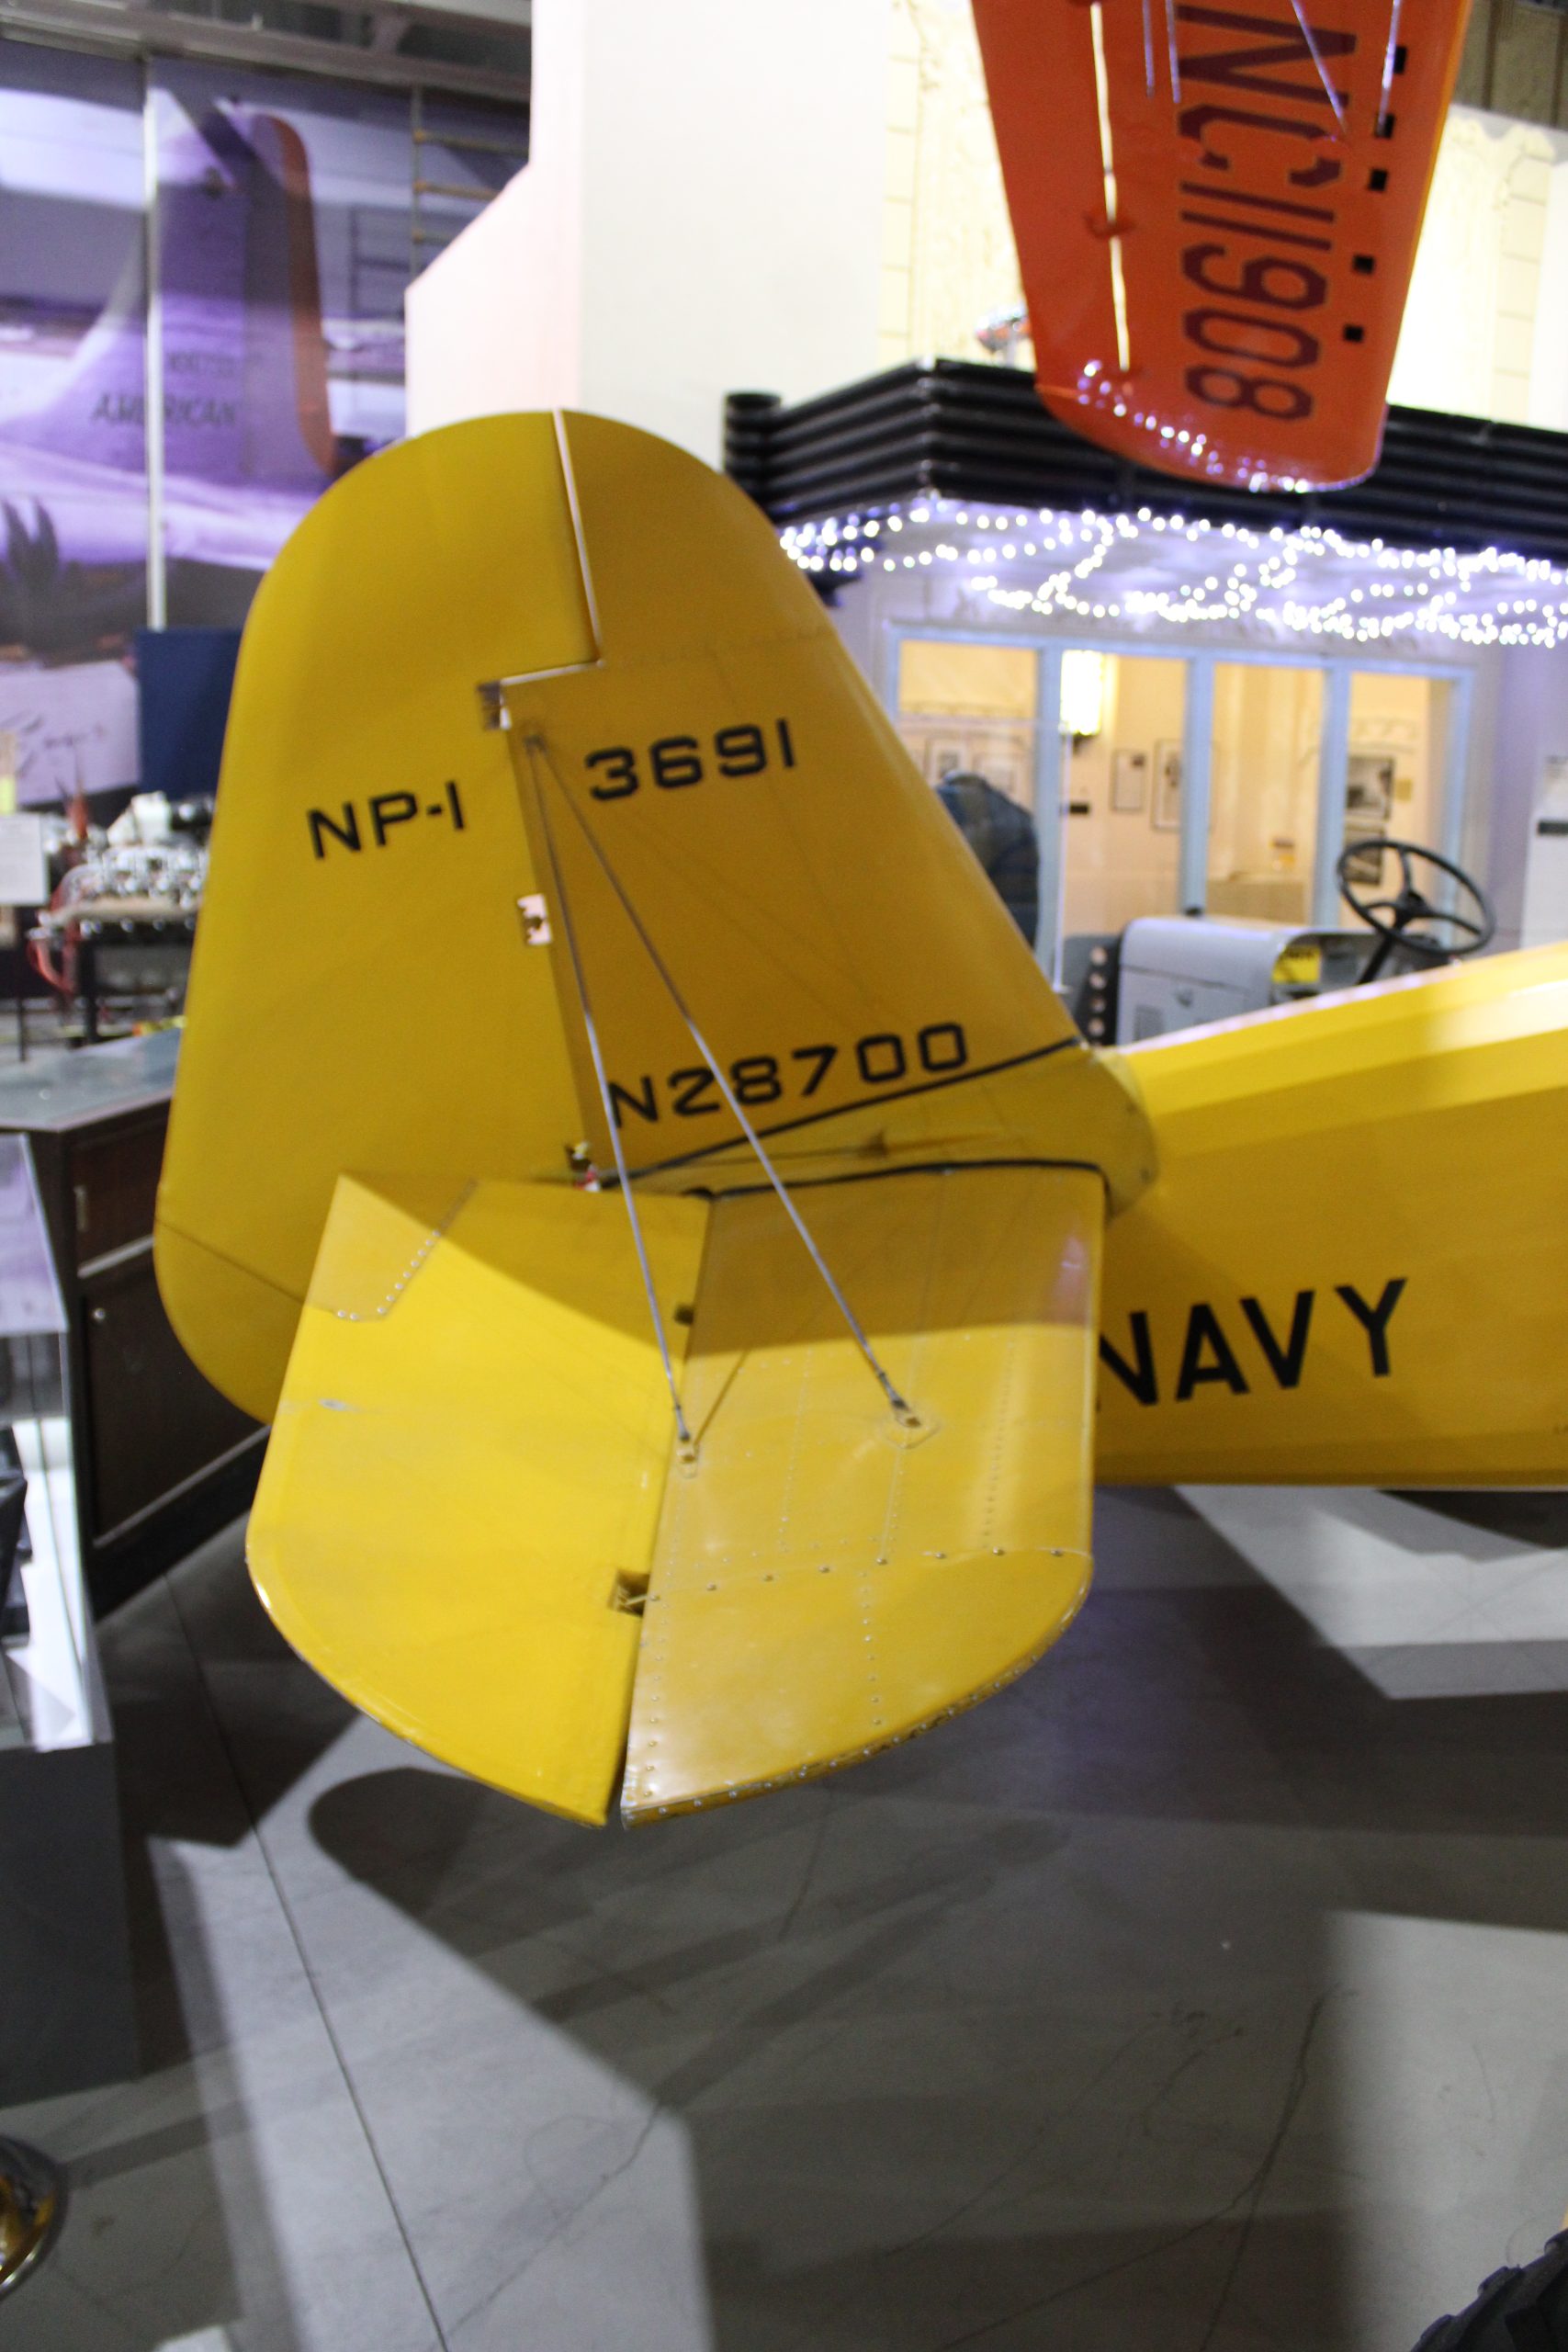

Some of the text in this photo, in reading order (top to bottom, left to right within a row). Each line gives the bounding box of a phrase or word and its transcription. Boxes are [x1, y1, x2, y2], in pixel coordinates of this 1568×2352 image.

[1177, 3, 1357, 421] NC11908
[584, 718, 797, 802] 3691
[307, 780, 466, 859] NP-1
[606, 1022, 967, 1129] N28700
[1098, 1277, 1407, 1406] NAVY
